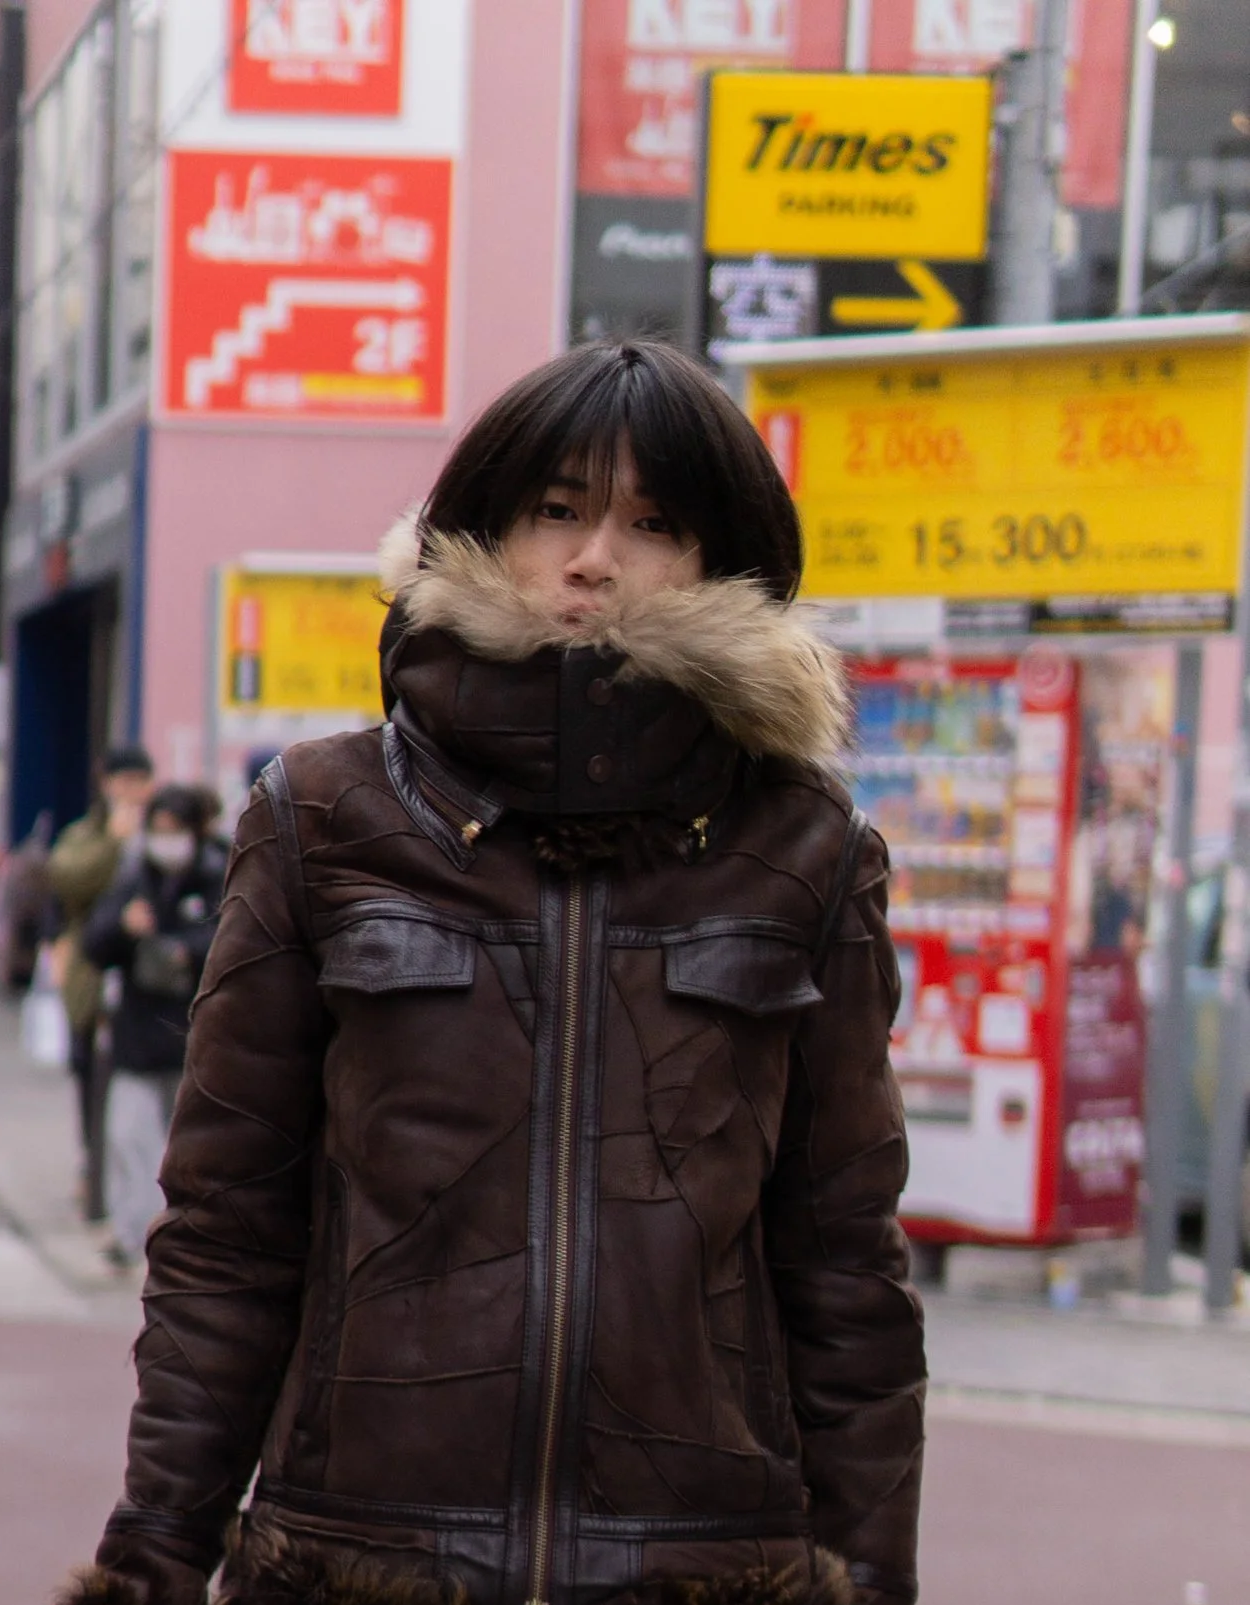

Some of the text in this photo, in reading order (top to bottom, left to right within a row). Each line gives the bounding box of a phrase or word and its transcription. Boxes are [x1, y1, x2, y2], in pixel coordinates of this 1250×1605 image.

[913, 0, 1031, 53] KE
[747, 111, 956, 176] Times
[778, 192, 917, 219] PARKING
[352, 316, 424, 374] 2F
[991, 513, 1089, 567] 300
